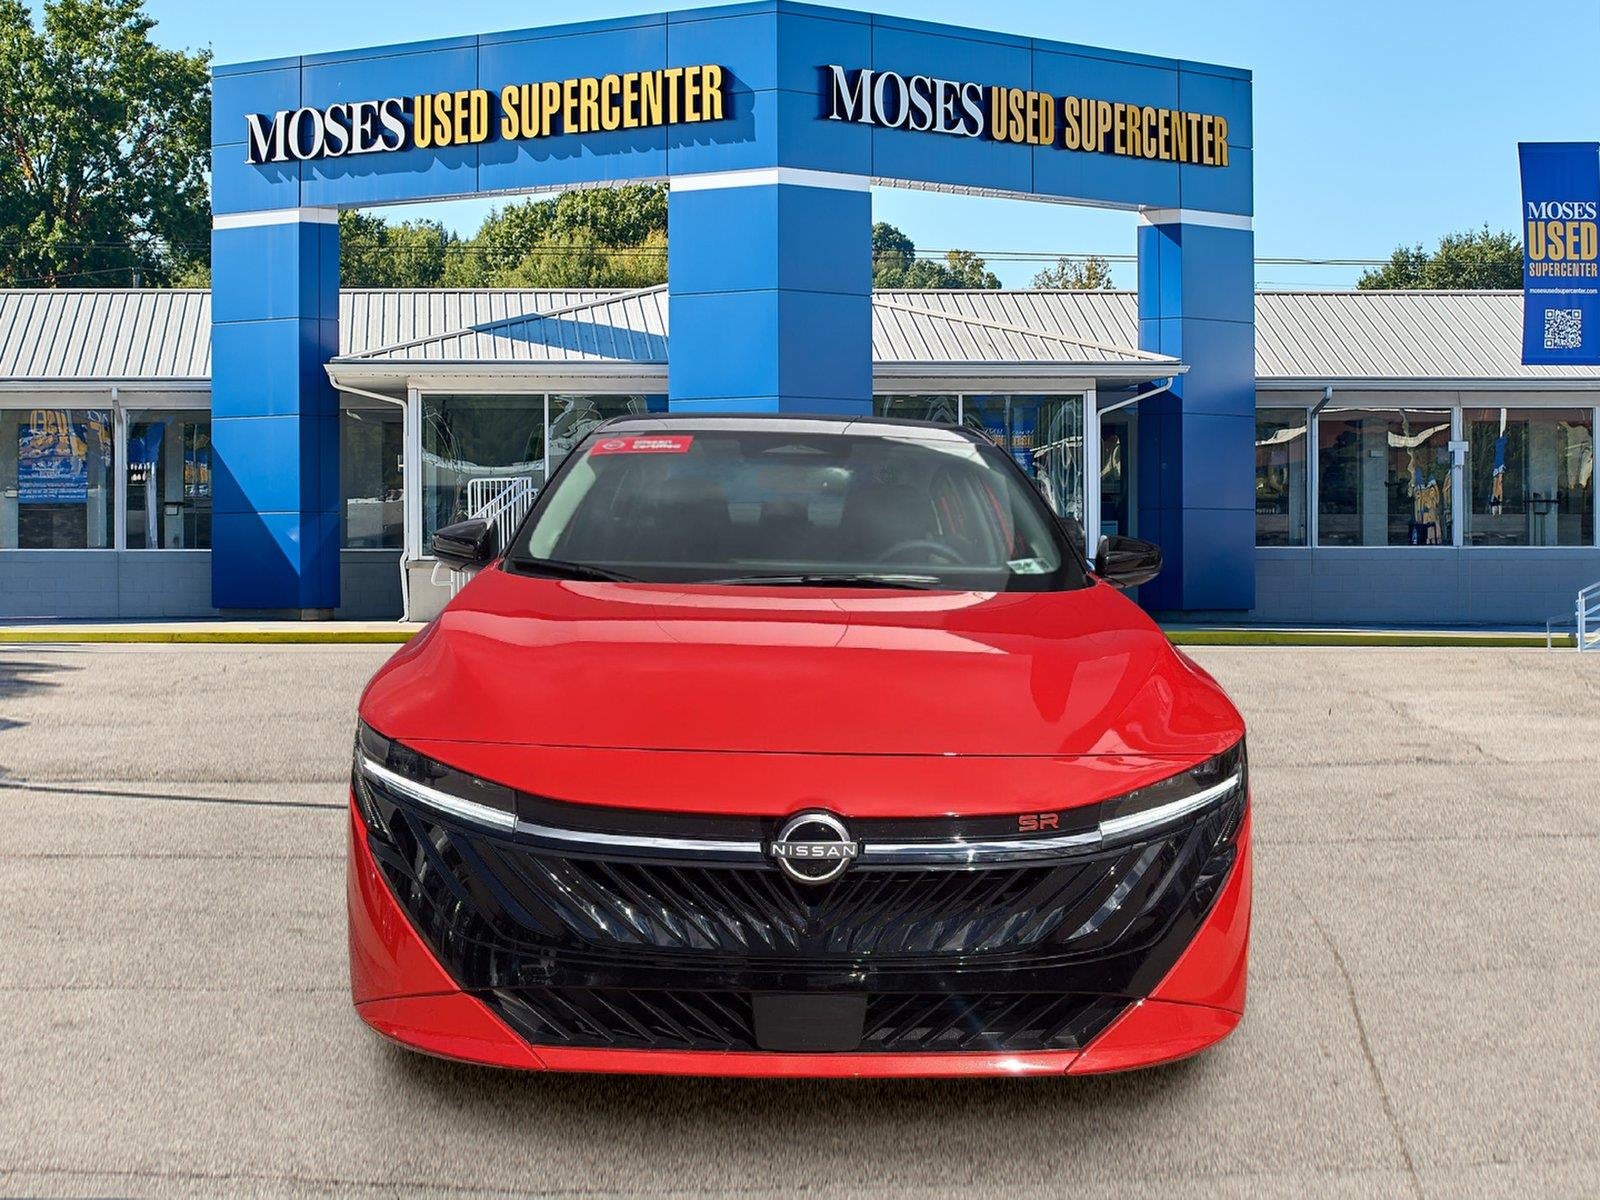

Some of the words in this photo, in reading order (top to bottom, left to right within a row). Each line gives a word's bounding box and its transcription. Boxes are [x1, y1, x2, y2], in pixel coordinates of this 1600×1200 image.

[245, 97, 405, 164] MOSES
[413, 88, 488, 149] USED
[500, 63, 724, 141] SUPERCENTER
[828, 64, 984, 138] MOSES
[991, 86, 1054, 145] USED
[1064, 95, 1229, 166] SUPERCENTER
[1527, 201, 1597, 220] MOSES
[1528, 220, 1598, 261] USED
[1529, 262, 1598, 277] SUPERCENTER
[1529, 287, 1598, 295] mosesusedsupercenter.com
[1018, 814, 1060, 831] SR
[772, 843, 857, 858] NISSAN
